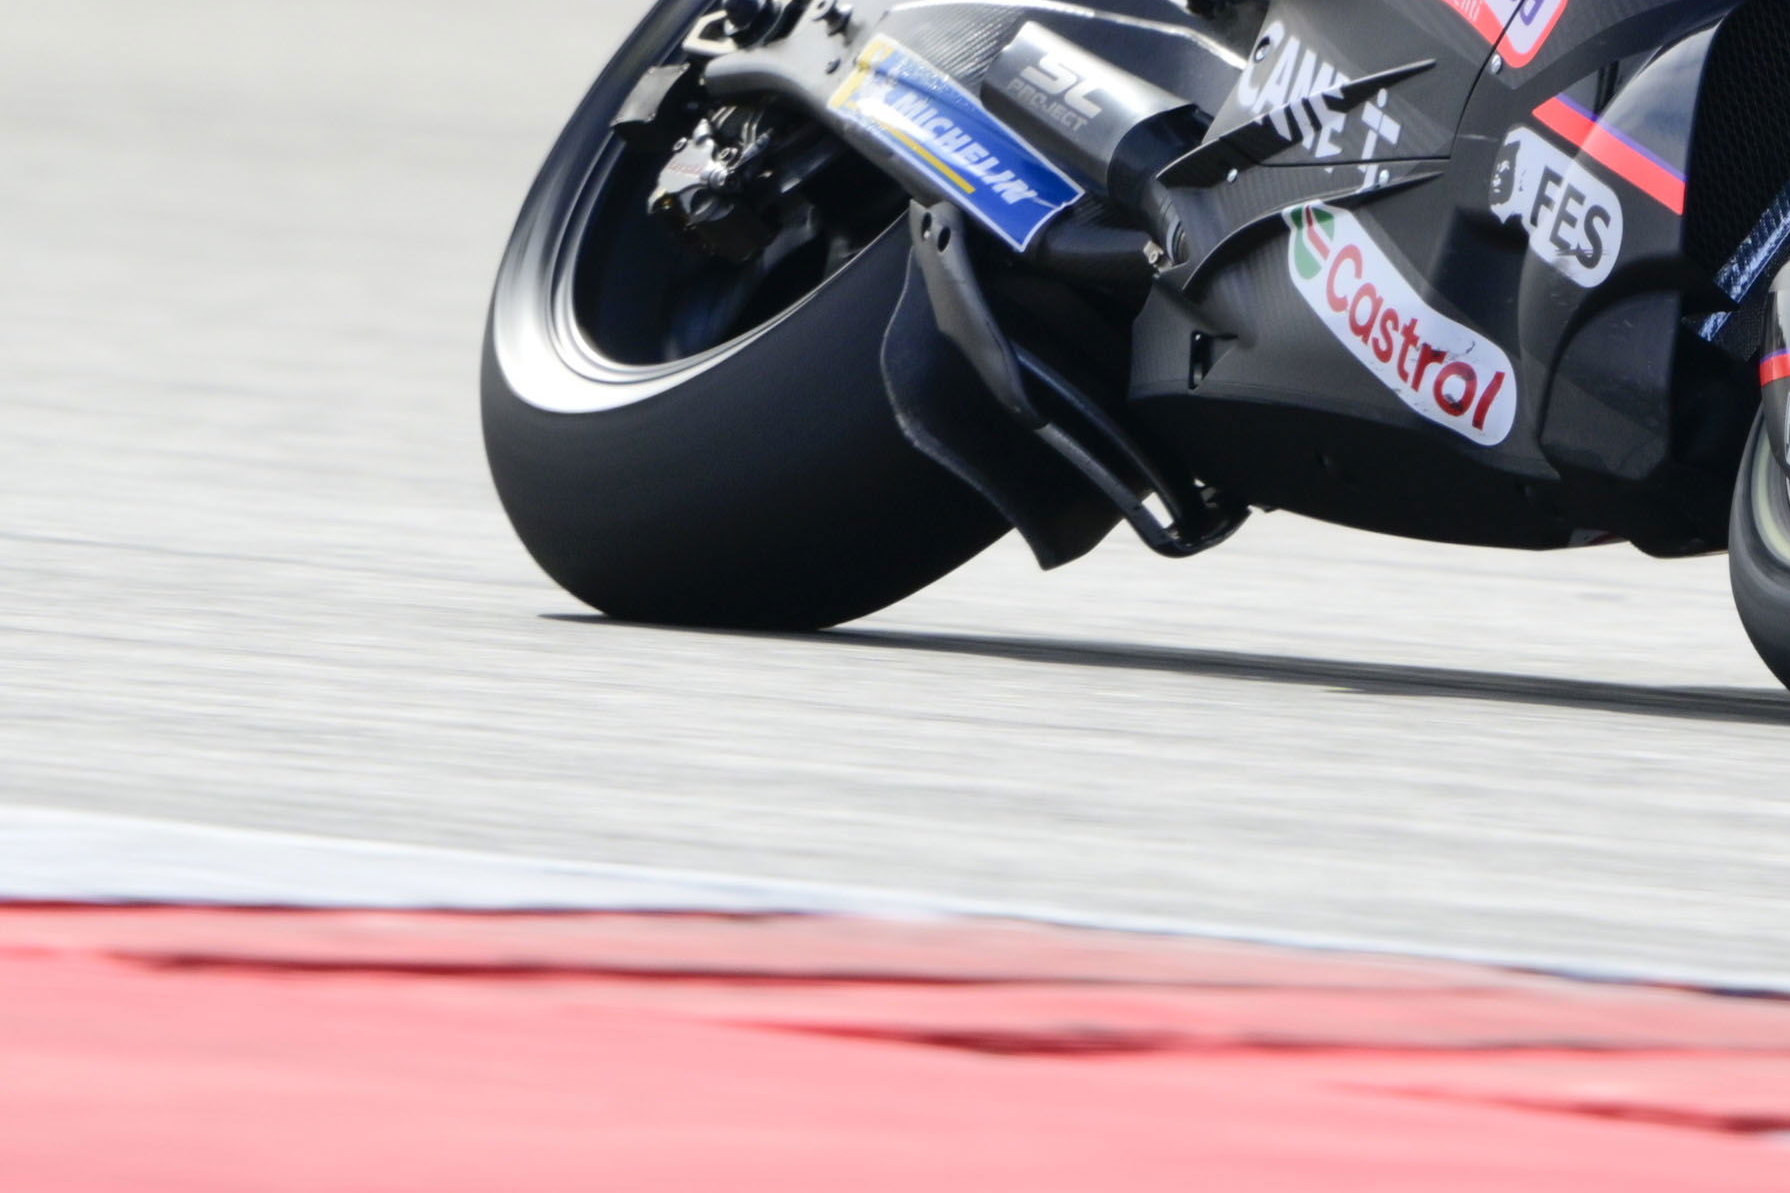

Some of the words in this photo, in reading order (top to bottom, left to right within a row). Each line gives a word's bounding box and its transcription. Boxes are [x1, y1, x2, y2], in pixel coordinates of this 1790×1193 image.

[1008, 77, 1090, 133] PROJECT
[1020, 52, 1100, 118] SC
[893, 92, 1037, 204] MICHELIN
[1326, 246, 1505, 431] Castrol
